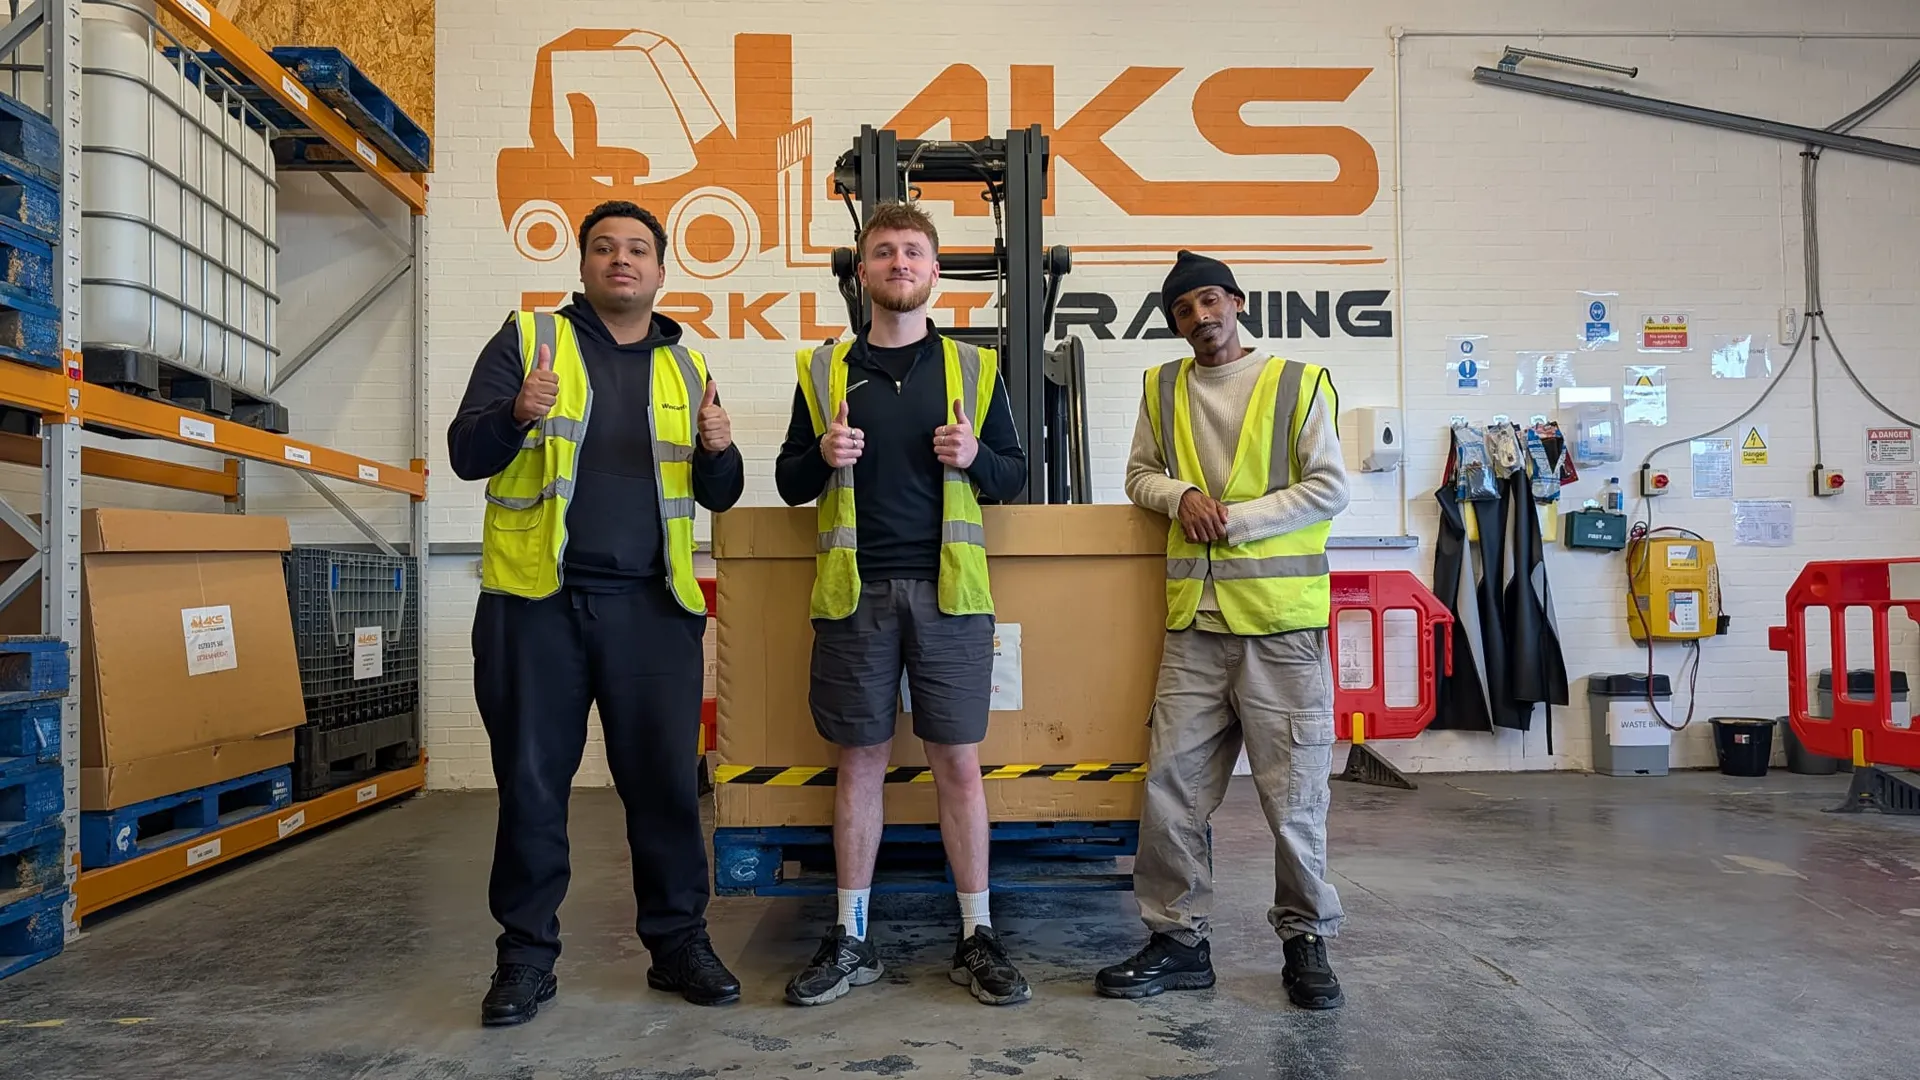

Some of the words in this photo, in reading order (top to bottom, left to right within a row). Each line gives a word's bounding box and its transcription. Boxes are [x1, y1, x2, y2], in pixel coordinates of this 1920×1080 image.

[826, 63, 1379, 216] 4KS
[994, 290, 1393, 339] RANING
[1744, 450, 1765, 458] Danger
